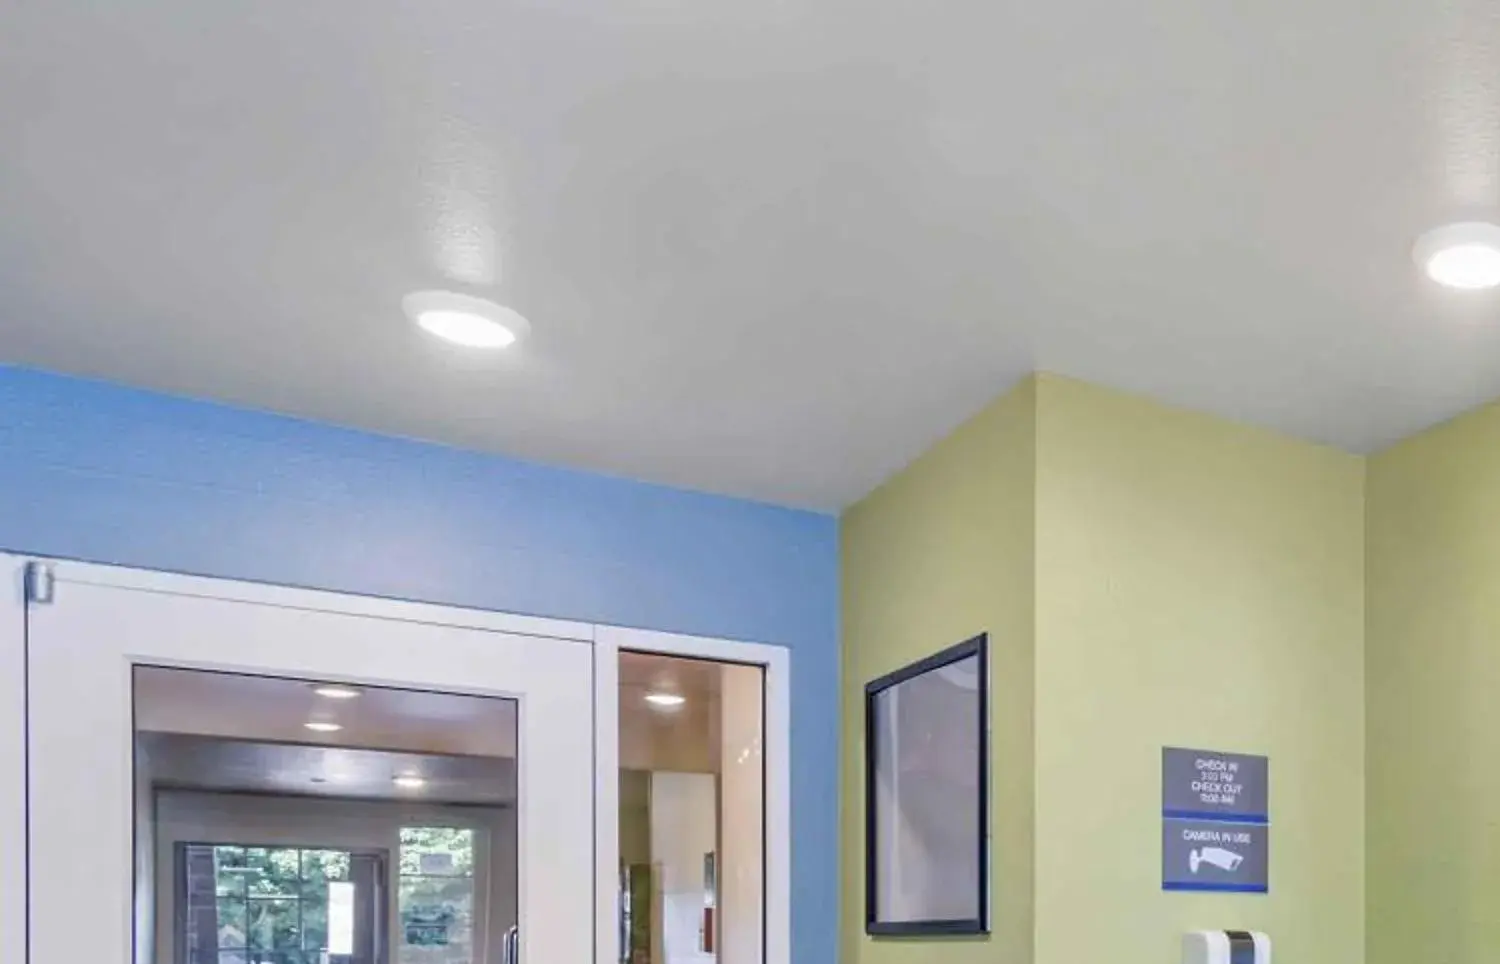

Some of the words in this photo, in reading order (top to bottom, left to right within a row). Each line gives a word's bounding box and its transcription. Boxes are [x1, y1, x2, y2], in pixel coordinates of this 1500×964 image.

[1195, 758, 1226, 772] CHECK
[1229, 762, 1239, 773] IN
[1220, 771, 1234, 782] PM
[1191, 781, 1221, 793] CHECK
[1222, 783, 1242, 796] OUT
[1183, 829, 1220, 842] CAMERA
[1221, 831, 1231, 842] IN
[1233, 832, 1251, 844] USE
